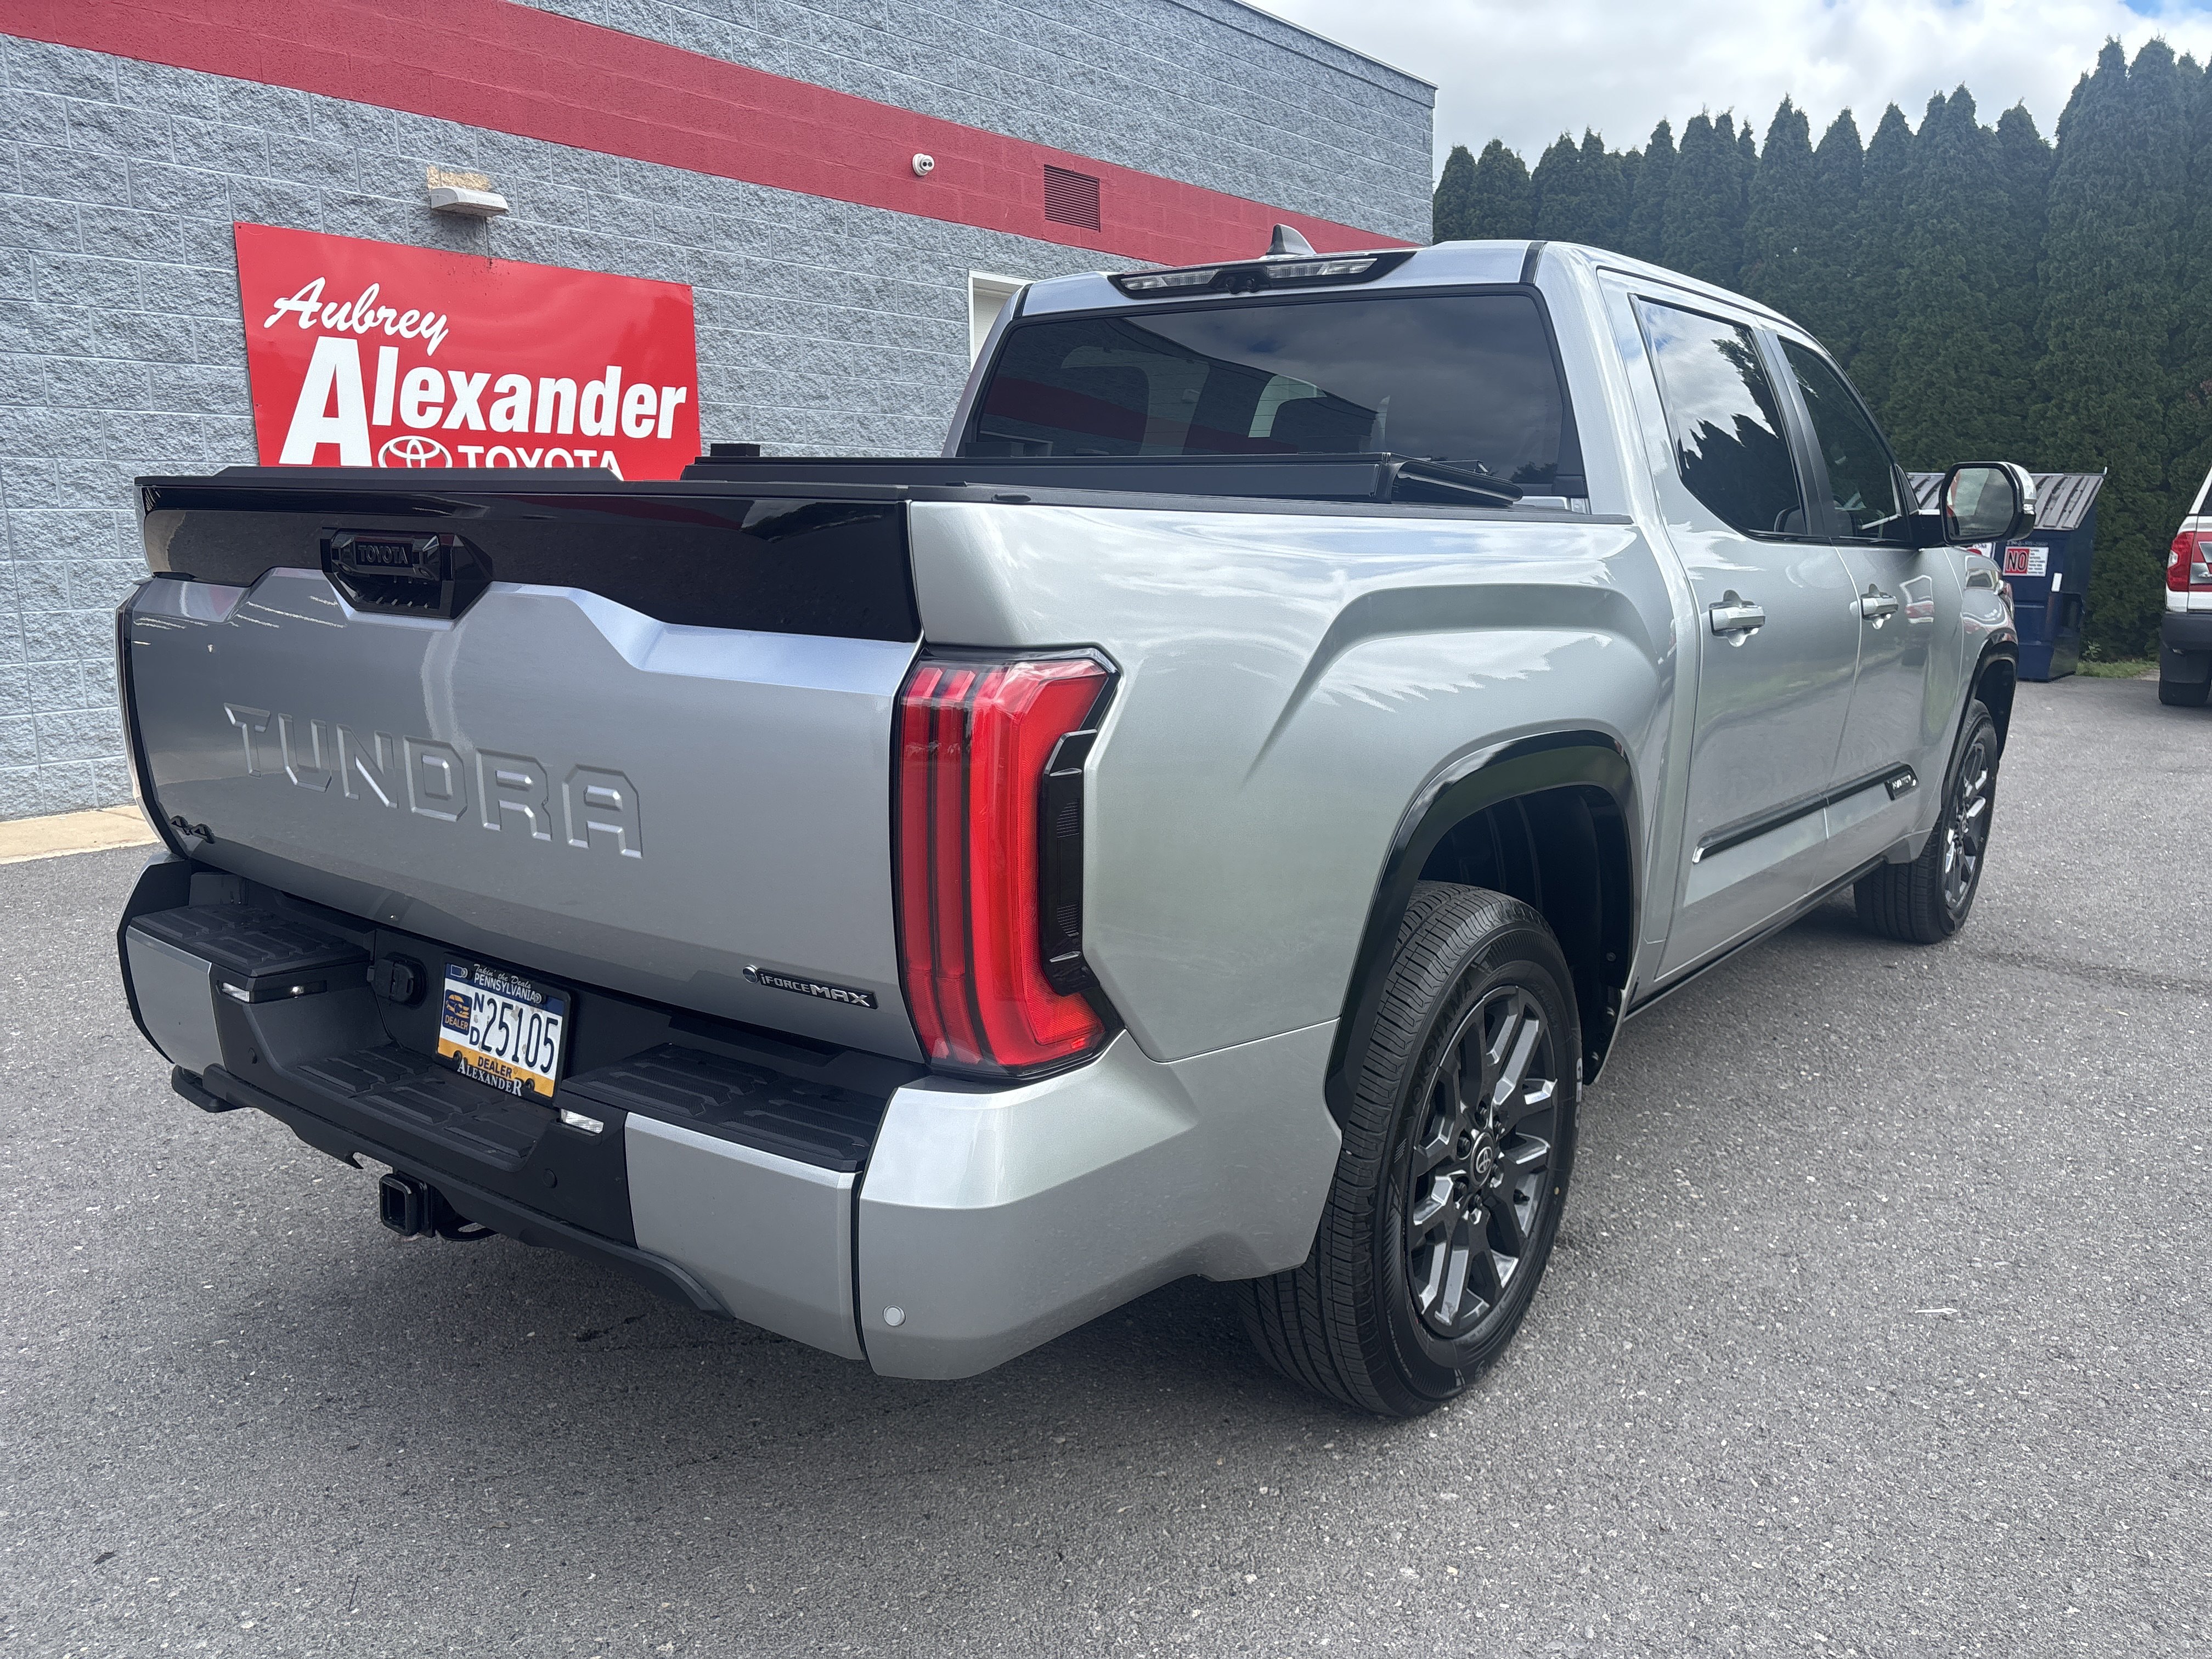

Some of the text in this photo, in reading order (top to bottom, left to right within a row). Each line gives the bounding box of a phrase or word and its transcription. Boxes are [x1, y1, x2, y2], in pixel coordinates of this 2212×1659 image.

[264, 277, 448, 356] Aubrey
[279, 336, 686, 466] Alexander
[457, 445, 624, 481] TOYOTA
[358, 545, 409, 565] TOYOTA
[2006, 550, 2028, 572] NO
[223, 702, 644, 859] TUNDRA
[474, 972, 537, 1003] PENNSYLVANIA
[498, 973, 509, 981] the
[511, 975, 532, 989] Deals
[444, 1014, 469, 1031] DEALER
[481, 998, 558, 1074] 25105
[456, 1058, 522, 1097] ALEXANDER
[477, 1056, 513, 1079] DEALER
